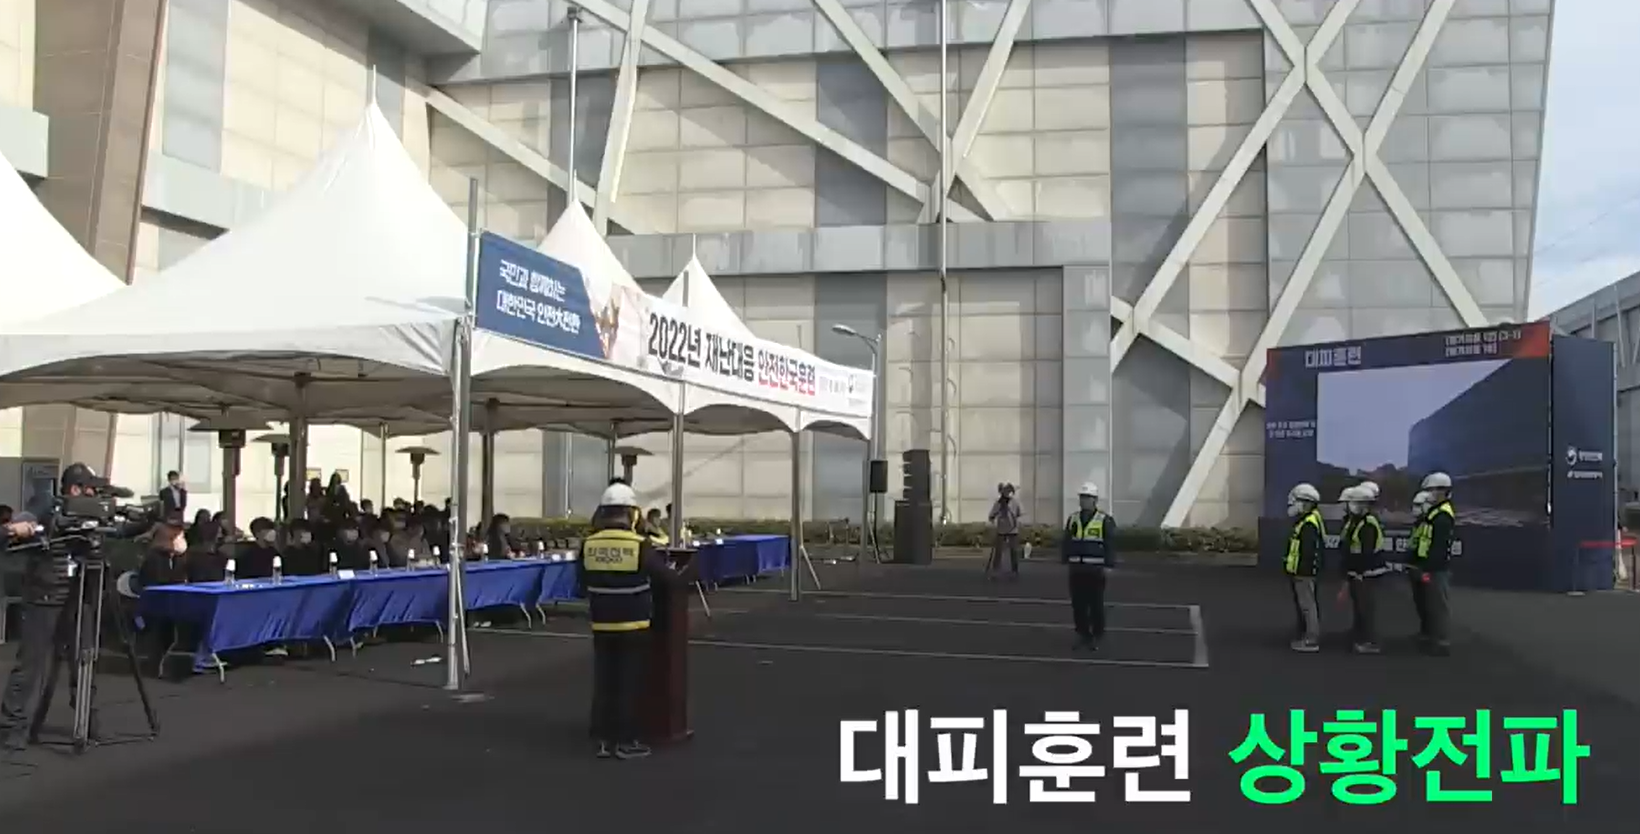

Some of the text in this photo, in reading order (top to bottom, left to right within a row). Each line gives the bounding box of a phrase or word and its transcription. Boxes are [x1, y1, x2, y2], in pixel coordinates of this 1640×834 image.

[499, 259, 567, 303] 국민과 함께하는
[496, 289, 537, 322] 대한민국
[648, 312, 701, 368] 2022년
[705, 332, 755, 382] 재난대응
[757, 349, 816, 396] 안전한국훈련
[1305, 346, 1362, 368] 대피훈련
